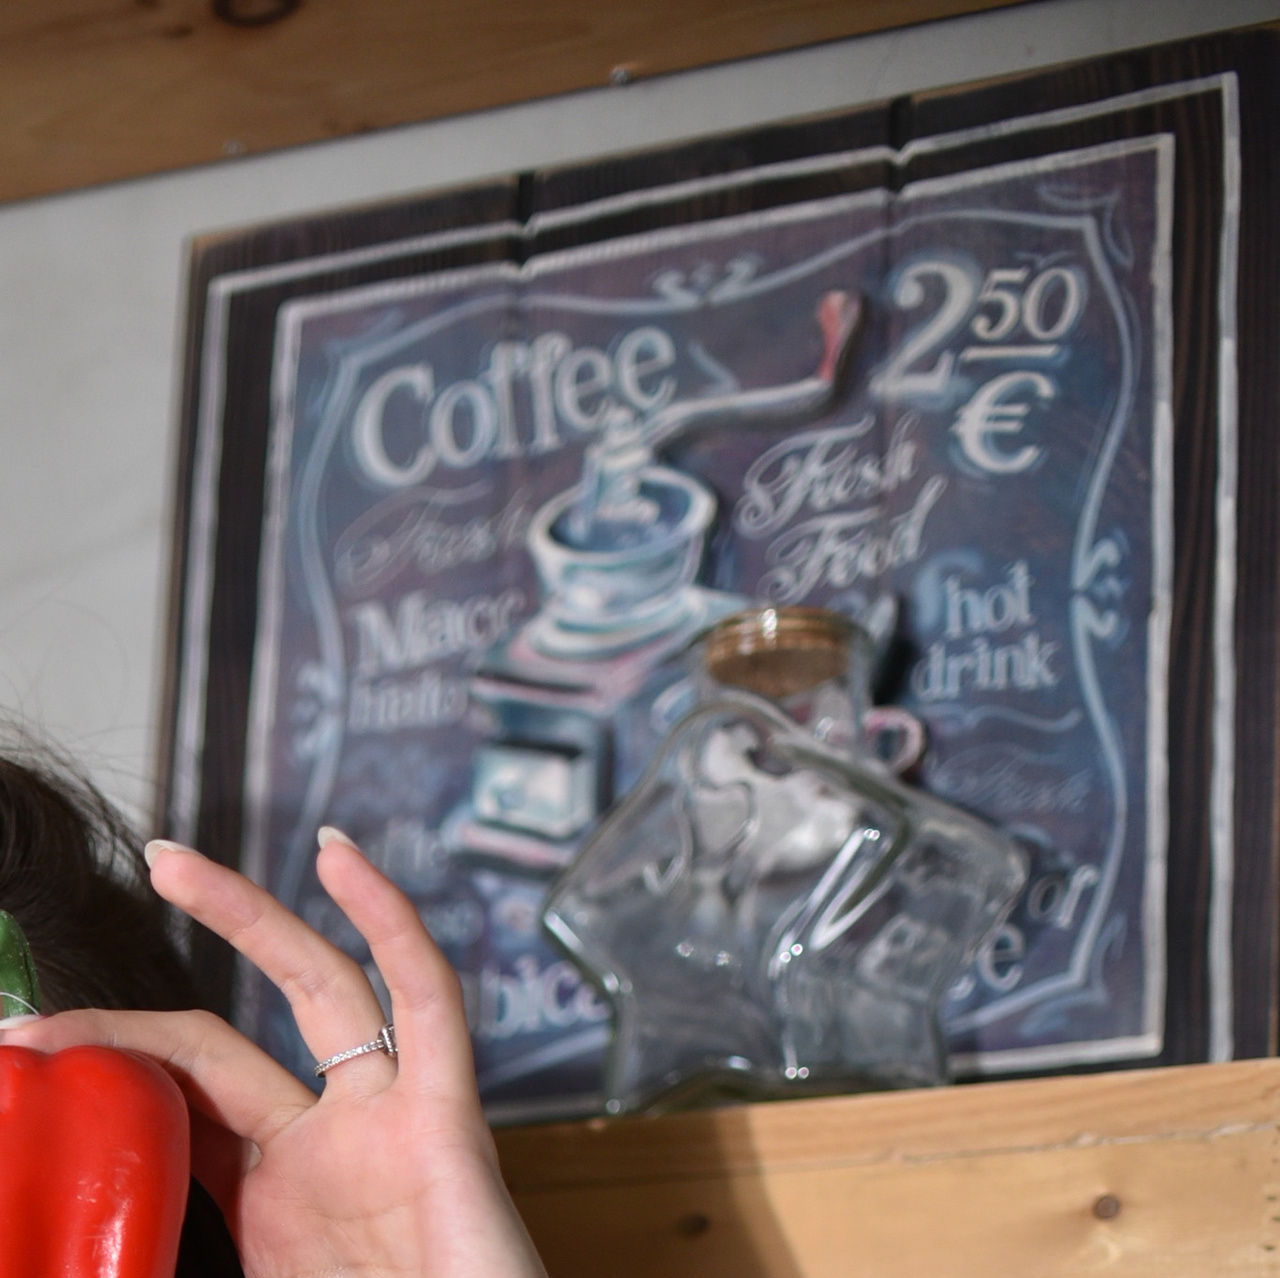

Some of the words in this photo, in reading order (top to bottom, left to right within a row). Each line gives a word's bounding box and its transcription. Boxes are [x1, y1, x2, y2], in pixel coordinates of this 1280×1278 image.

[352, 326, 678, 488] Coffee
[734, 412, 922, 540] Fresh
[760, 474, 948, 608] Food
[943, 560, 1035, 640] hot
[912, 632, 1058, 702] drink
